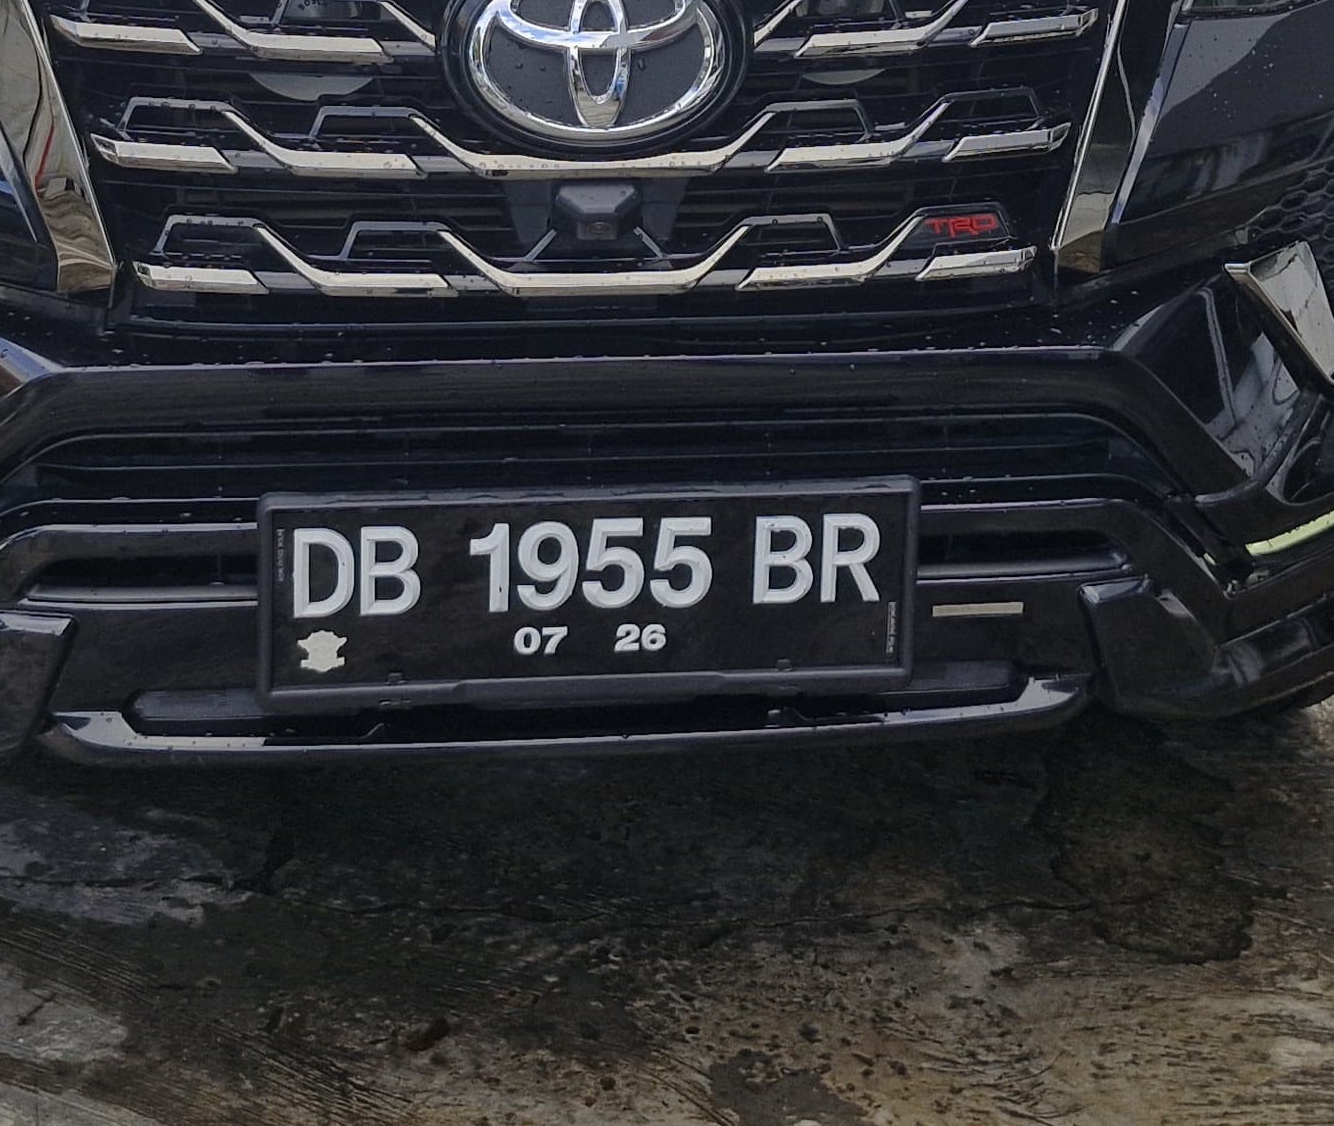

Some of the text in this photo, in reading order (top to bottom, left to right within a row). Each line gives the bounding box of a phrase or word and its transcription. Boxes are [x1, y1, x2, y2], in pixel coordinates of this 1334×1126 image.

[923, 213, 999, 239] TRD
[293, 526, 422, 619] DB
[469, 517, 713, 613] 1955
[752, 513, 880, 605] BR
[513, 623, 666, 655] 07 26
